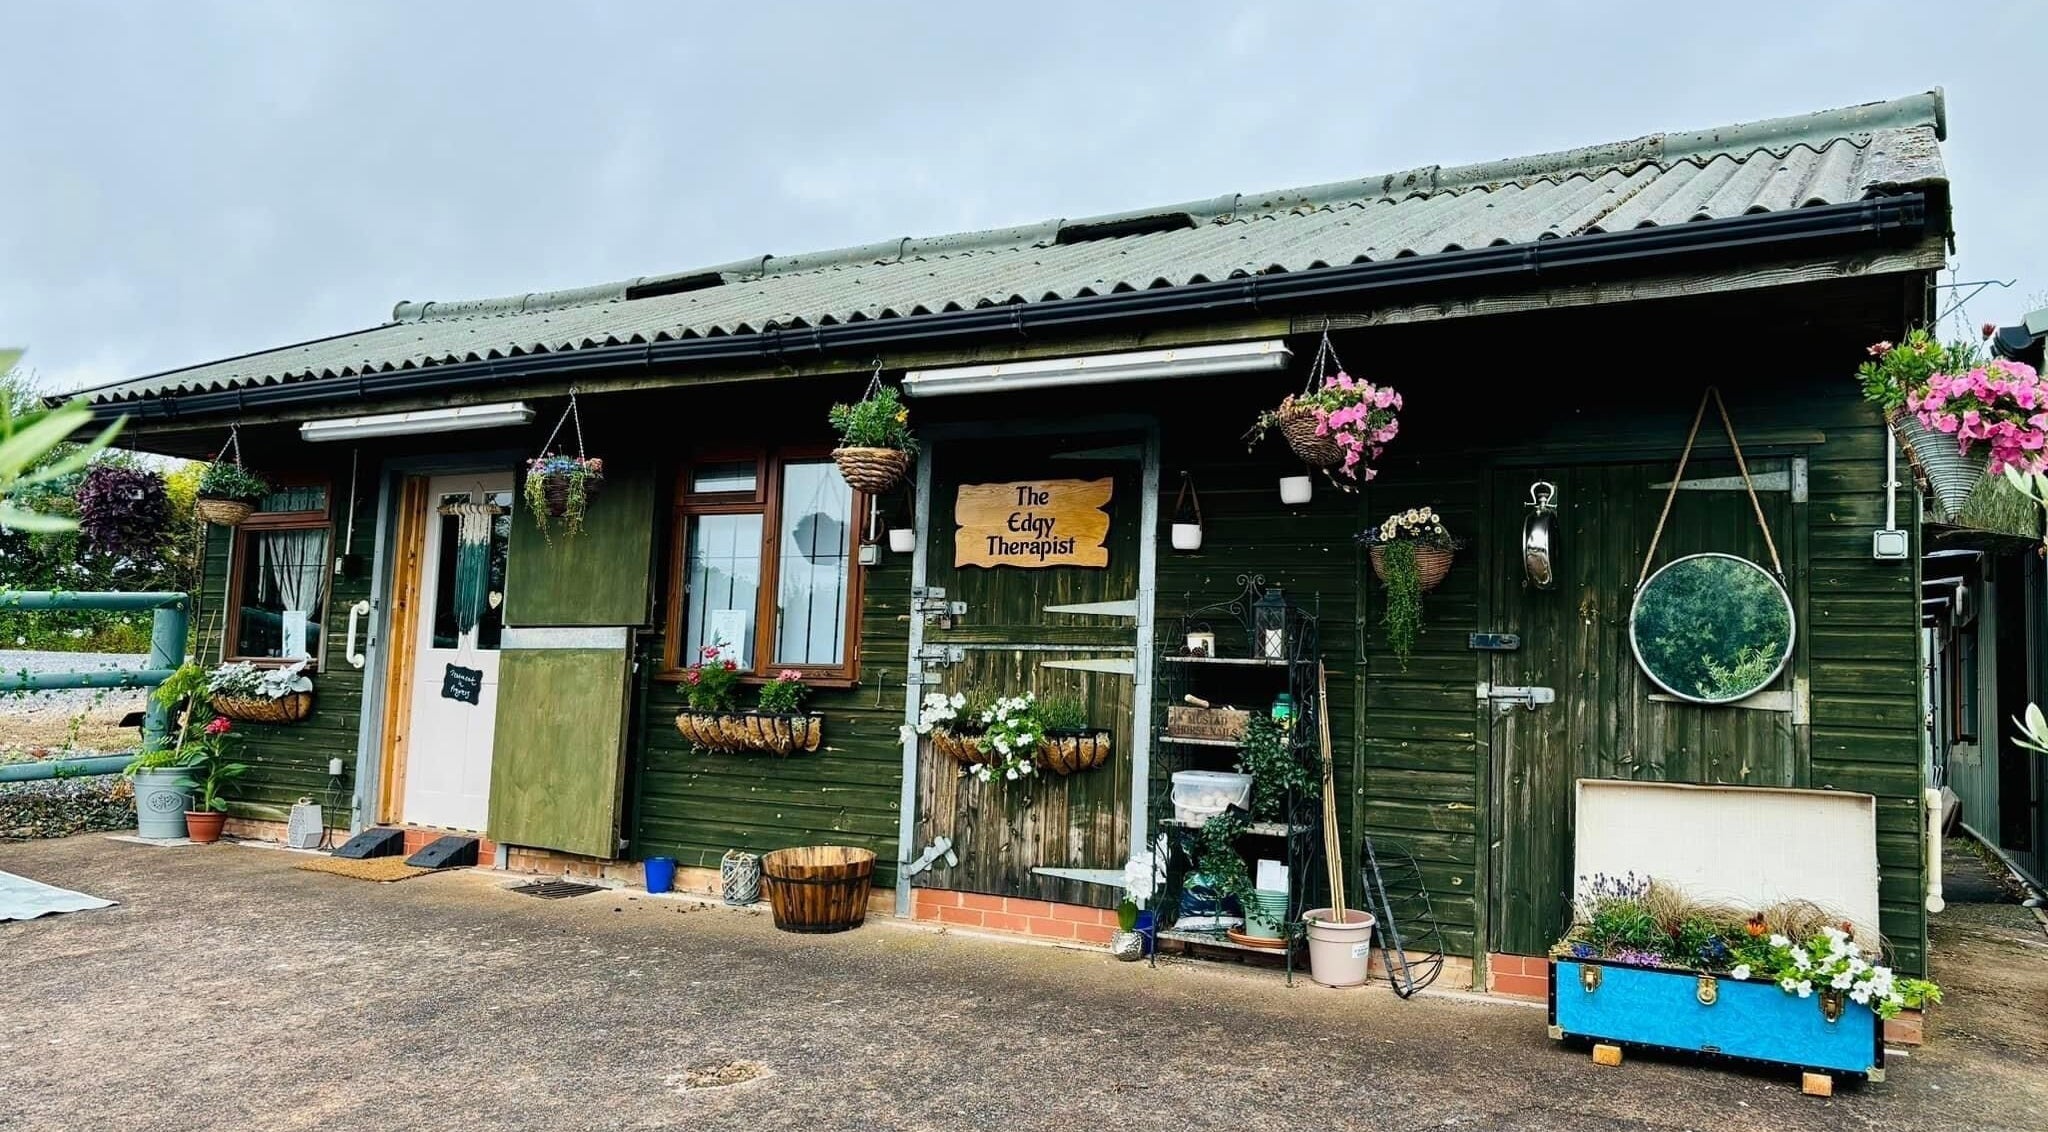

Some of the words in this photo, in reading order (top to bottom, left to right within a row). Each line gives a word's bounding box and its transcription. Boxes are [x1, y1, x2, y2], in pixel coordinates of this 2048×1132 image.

[1016, 486, 1049, 506] The
[1007, 512, 1056, 539] Edgy
[986, 535, 1076, 562] Therapist
